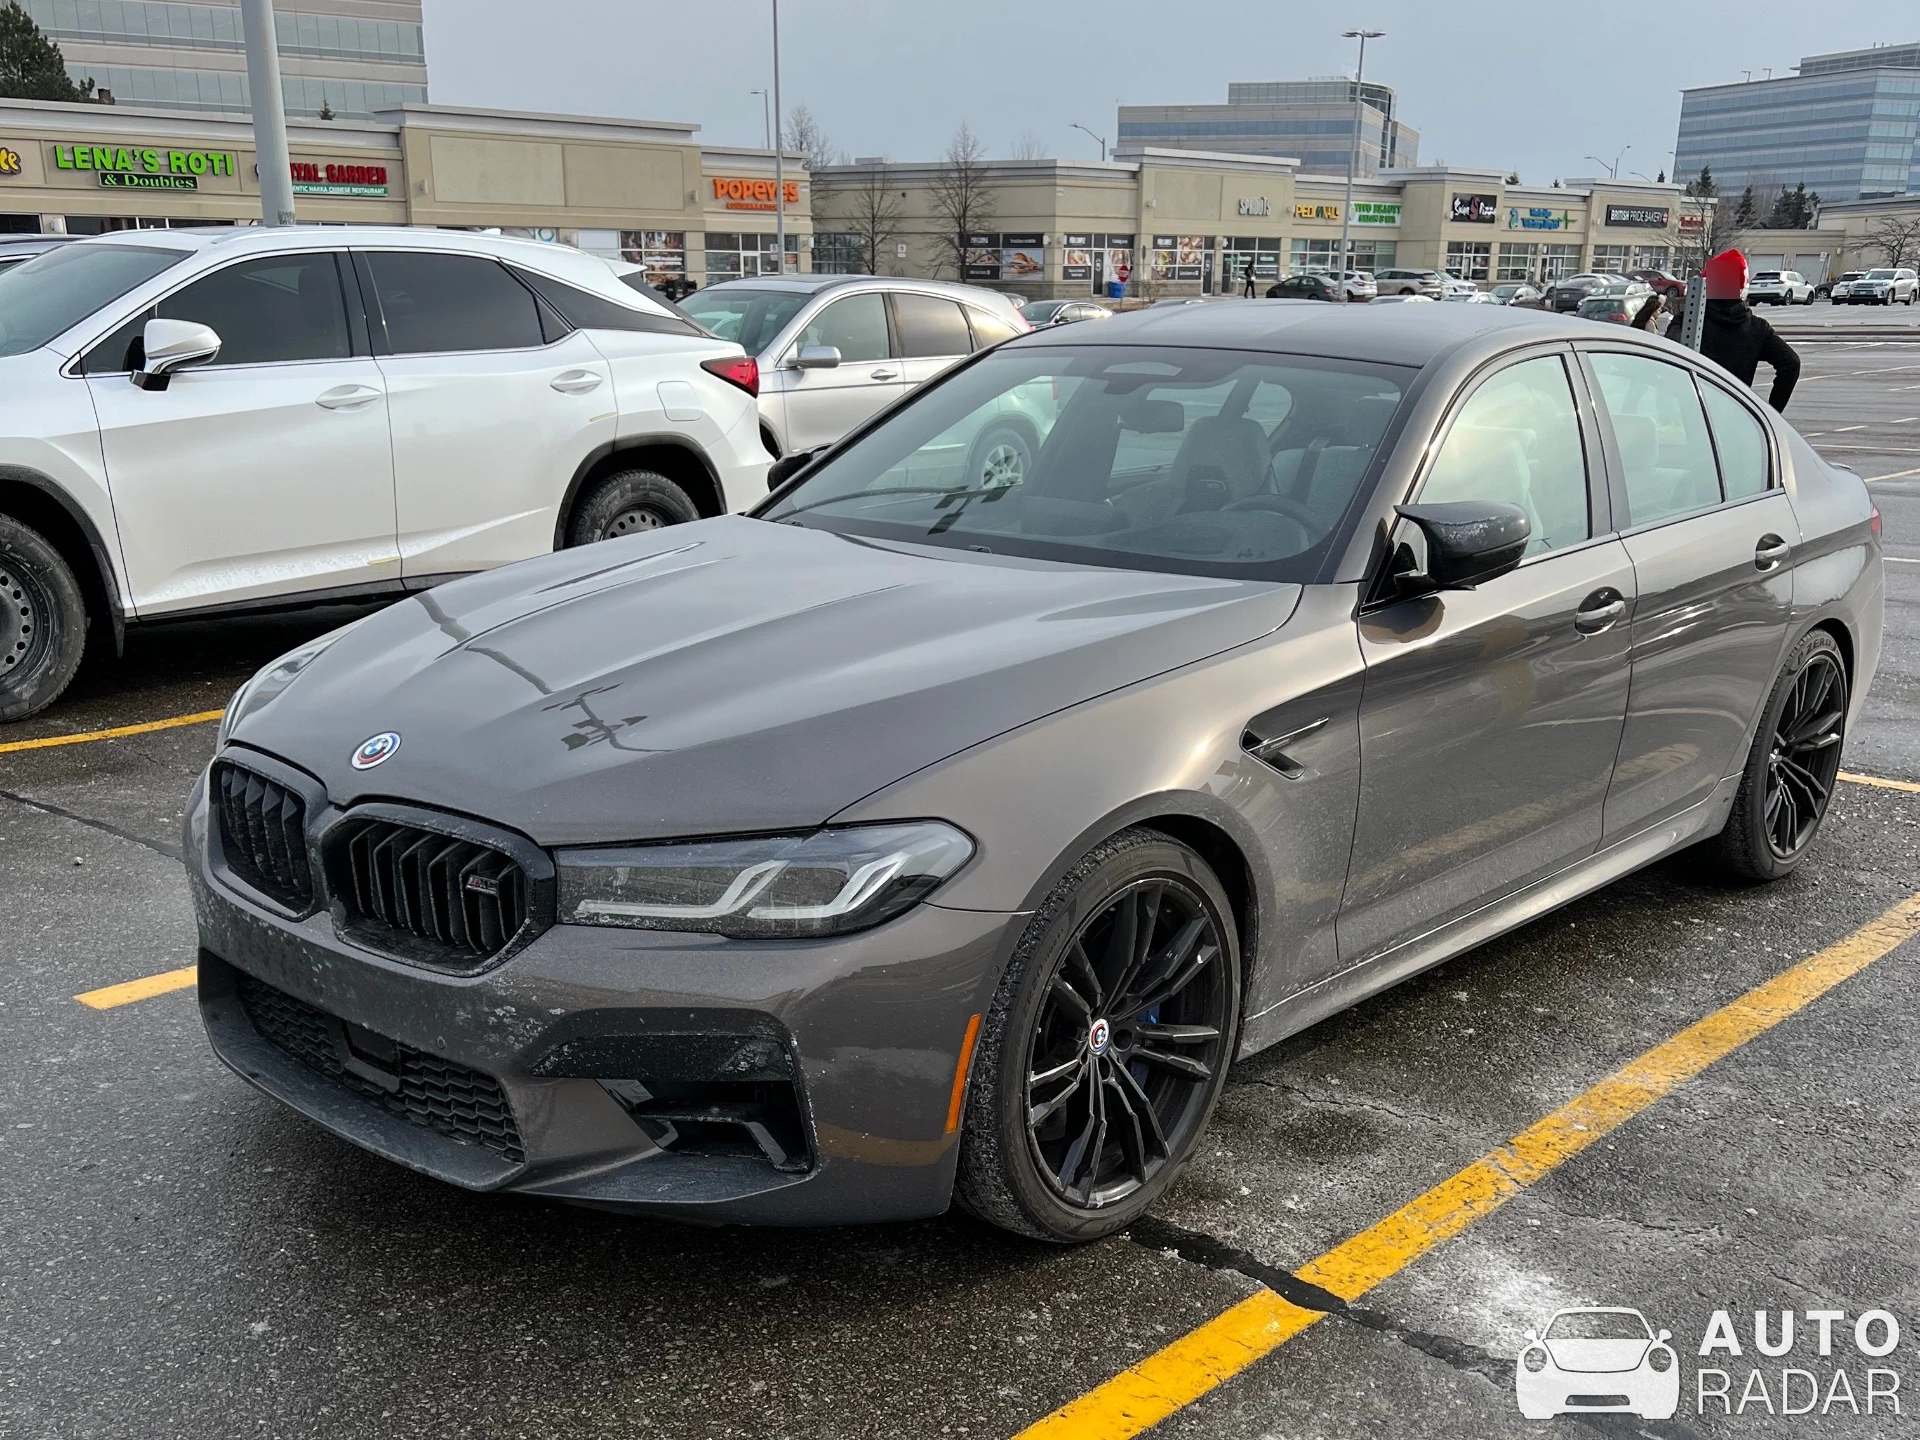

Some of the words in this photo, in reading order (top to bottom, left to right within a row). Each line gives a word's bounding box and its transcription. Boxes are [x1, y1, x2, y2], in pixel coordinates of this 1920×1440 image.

[54, 145, 161, 173] LENA'S
[168, 150, 234, 176] ROTI
[104, 173, 118, 186] &
[124, 174, 194, 188] Doubles
[325, 164, 387, 185] GARDEN
[352, 187, 385, 195] RESTAURANT
[1610, 209, 1629, 221] BRITISH
[1630, 210, 1644, 222] PRIDE
[1644, 211, 1662, 223] BAKERY
[1806, 637, 1832, 655] ZERO
